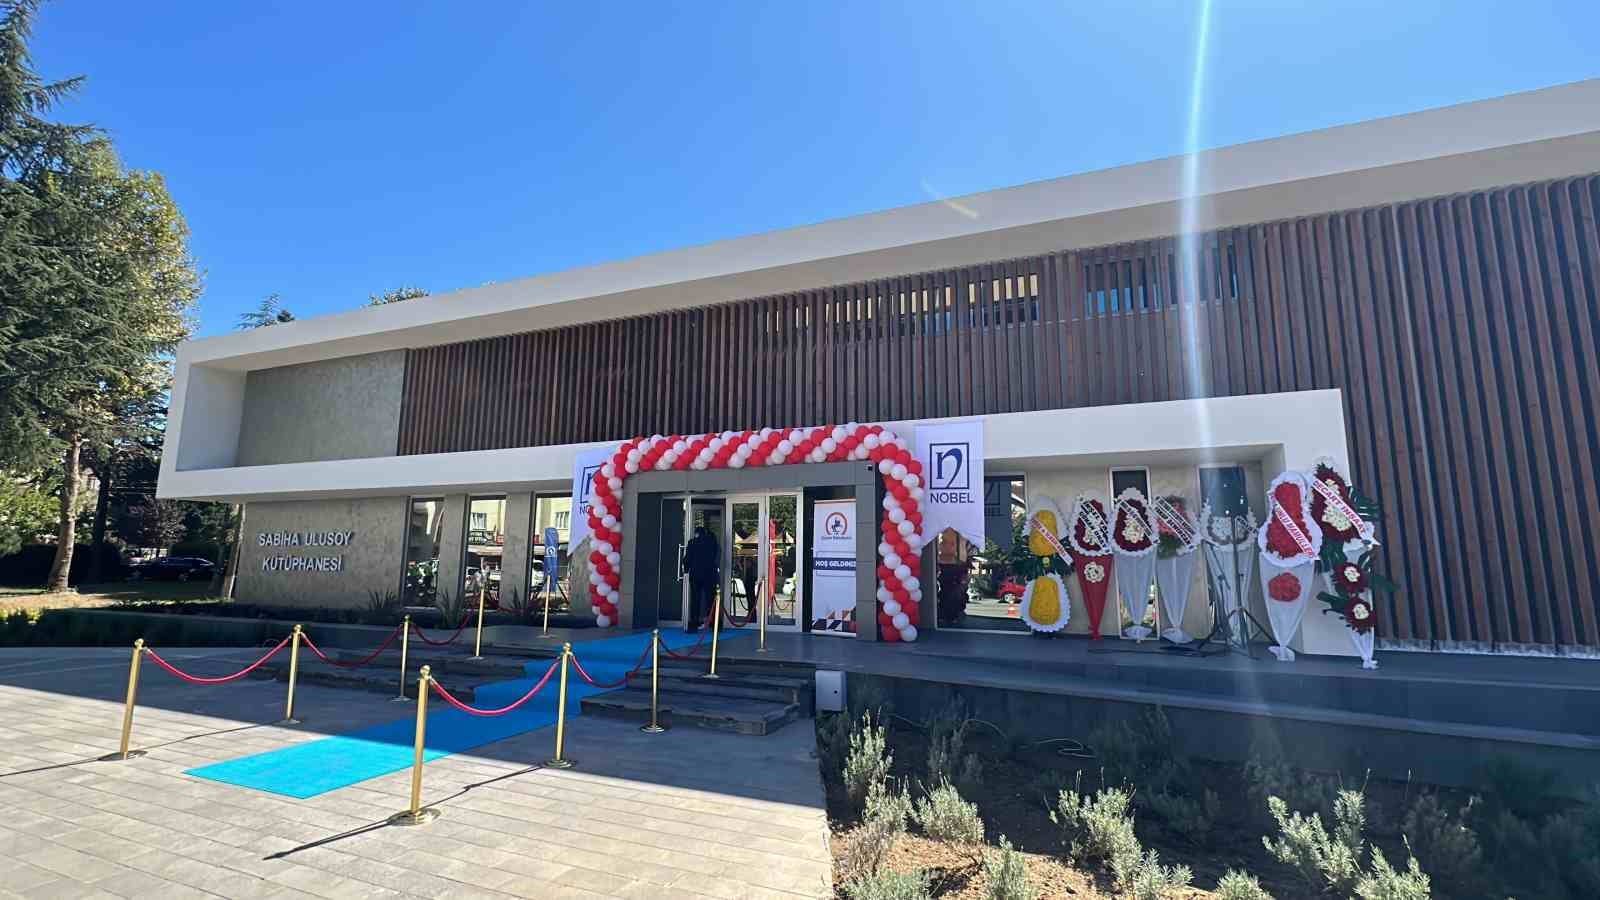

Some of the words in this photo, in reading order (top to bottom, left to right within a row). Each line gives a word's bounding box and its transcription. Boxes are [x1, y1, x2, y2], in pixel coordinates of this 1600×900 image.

[930, 493, 975, 504] NOBEL
[259, 529, 299, 546] SABİHA
[305, 530, 351, 546] ULUSOY
